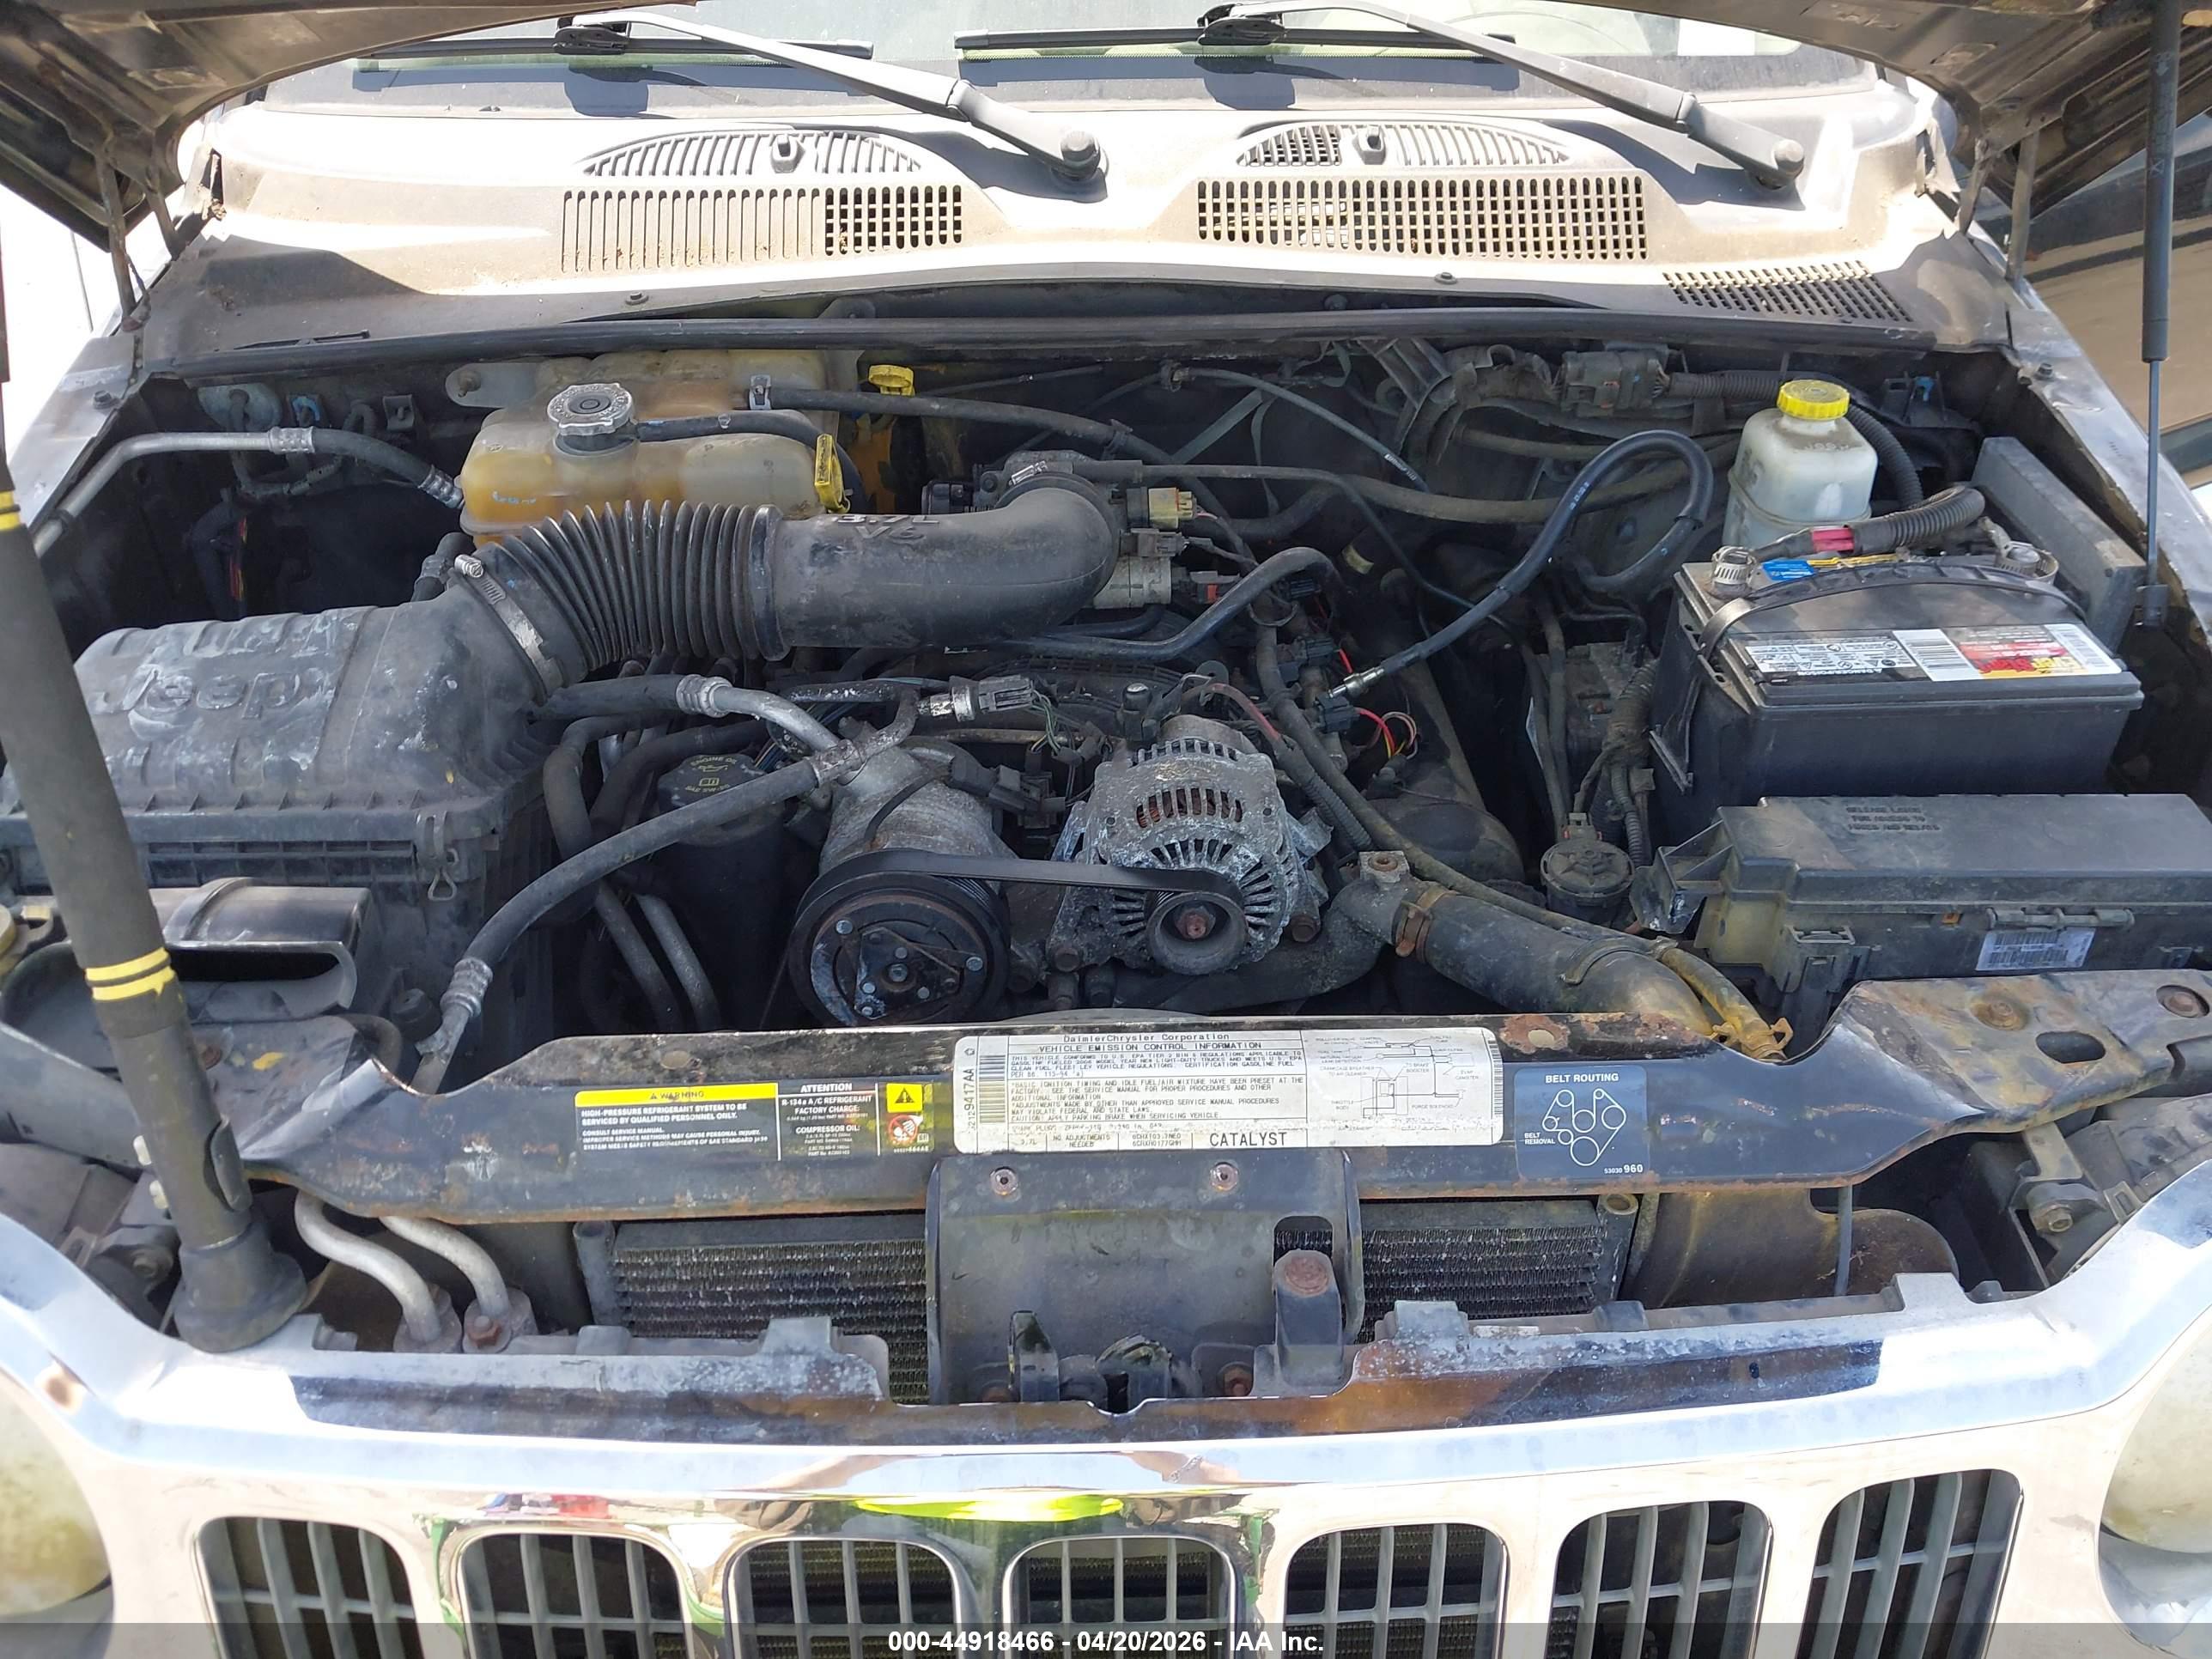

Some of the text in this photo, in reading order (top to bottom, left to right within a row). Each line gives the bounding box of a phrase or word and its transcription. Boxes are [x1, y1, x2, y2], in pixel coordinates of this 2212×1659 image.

[84, 664, 304, 720] Jeep
[1063, 1033, 1230, 1042] DaimlerChrysler Corporation
[1039, 1042, 1261, 1053] VEHICLE EMISSION CONTROL INFORMATION
[1545, 1073, 1620, 1084] BELT ROUTING
[800, 1083, 853, 1093] ATTENTION
[659, 1090, 705, 1100] WARNING
[781, 1095, 872, 1107] R-134a A/C REFRIGERANT
[581, 1107, 642, 1117] HIGH-PRESSURE
[642, 1104, 694, 1115] REFRIGERANT
[695, 1103, 725, 1112] SYSTEM
[725, 1103, 736, 1111] TO
[794, 1104, 860, 1115] FACTORY CHARGE:
[581, 1117, 618, 1127] SERVICED
[619, 1116, 629, 1125] BY
[630, 1115, 671, 1125] QUALIFIED
[672, 1113, 715, 1122] PERSONNEL
[795, 1124, 845, 1134] COMPRESSOR
[1209, 1132, 1287, 1147] CATALYST
[1623, 1164, 1644, 1174] 960
